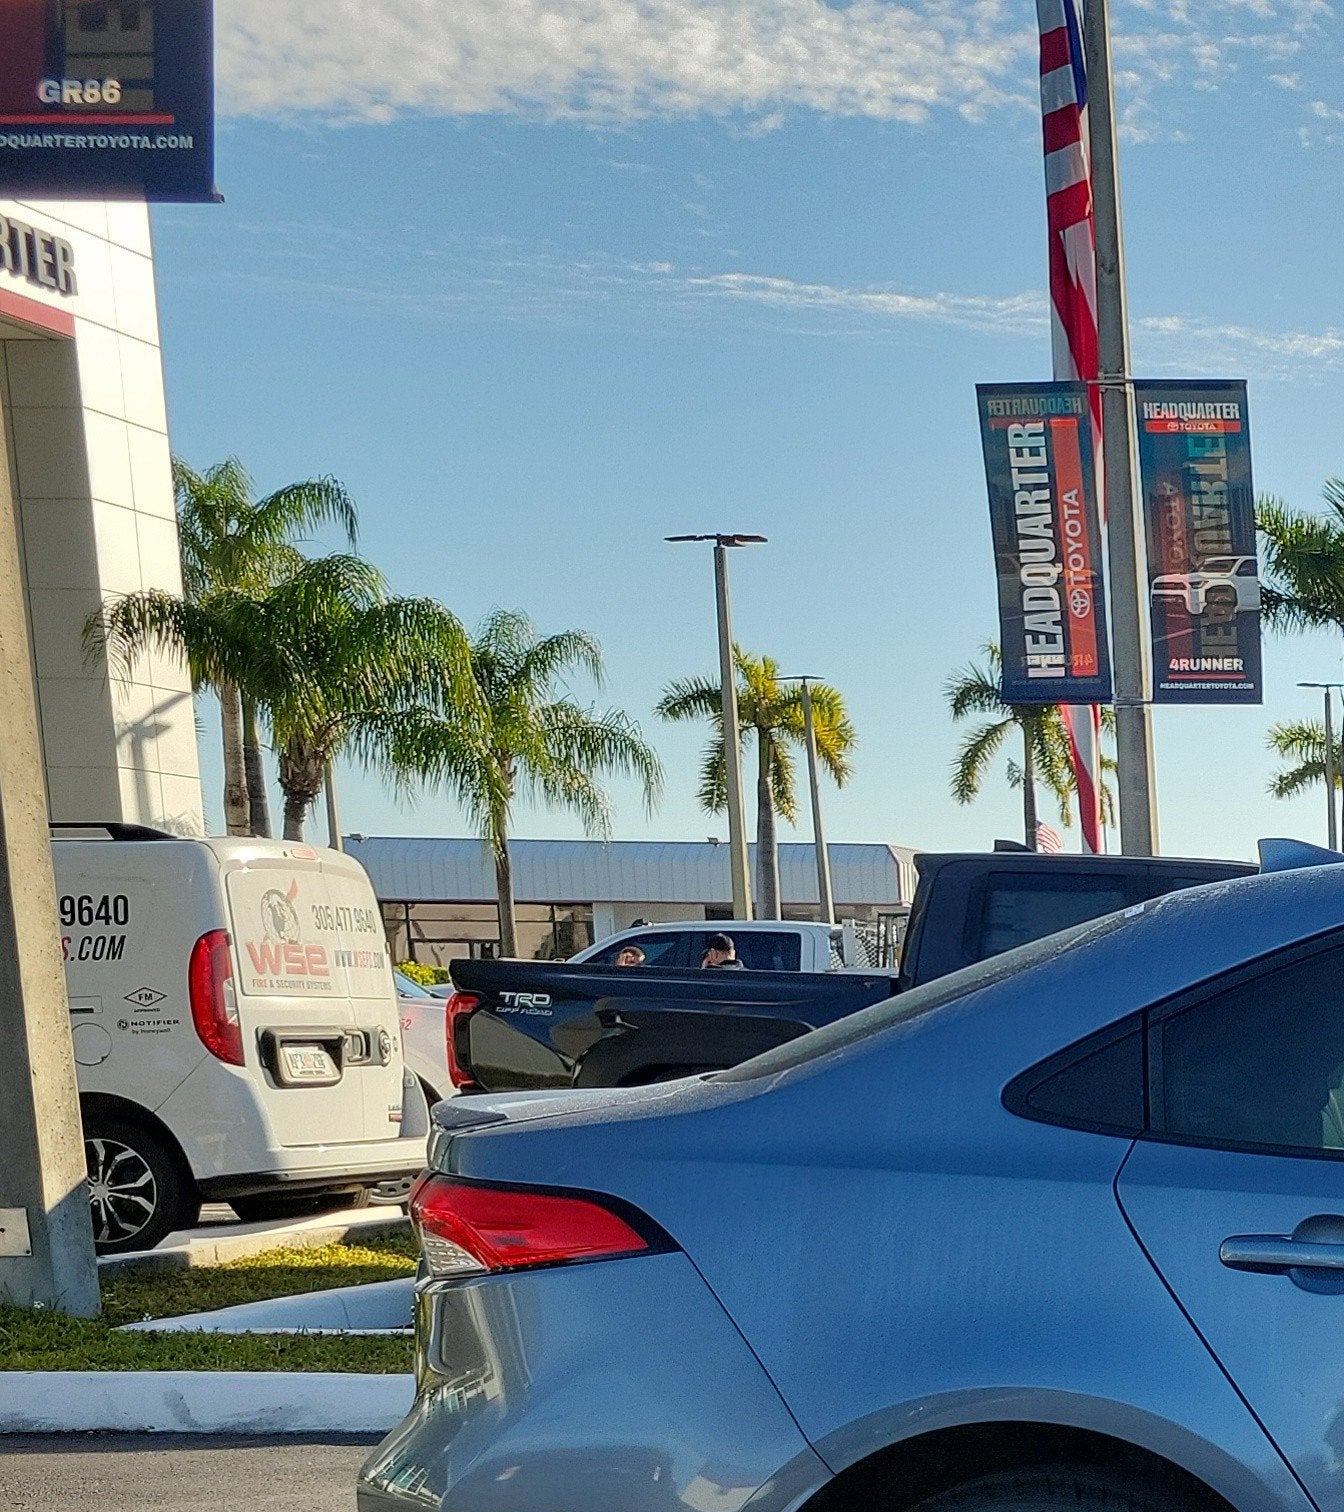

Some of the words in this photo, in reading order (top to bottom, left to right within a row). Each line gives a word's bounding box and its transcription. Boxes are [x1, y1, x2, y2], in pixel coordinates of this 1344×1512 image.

[39, 80, 121, 104] GR86
[1144, 402, 1239, 420] HEADQUARTER
[1180, 421, 1216, 431] TOYOTA
[1063, 488, 1086, 586] TOYOTA
[1008, 421, 1065, 678] HEADQUARTER
[1169, 658, 1243, 671] 4RUNNER
[60, 895, 129, 926] 9640
[312, 905, 376, 934] 305.477.9640
[138, 993, 153, 1001] FM
[499, 991, 550, 1007] TRD
[520, 1008, 552, 1016] ROAD
